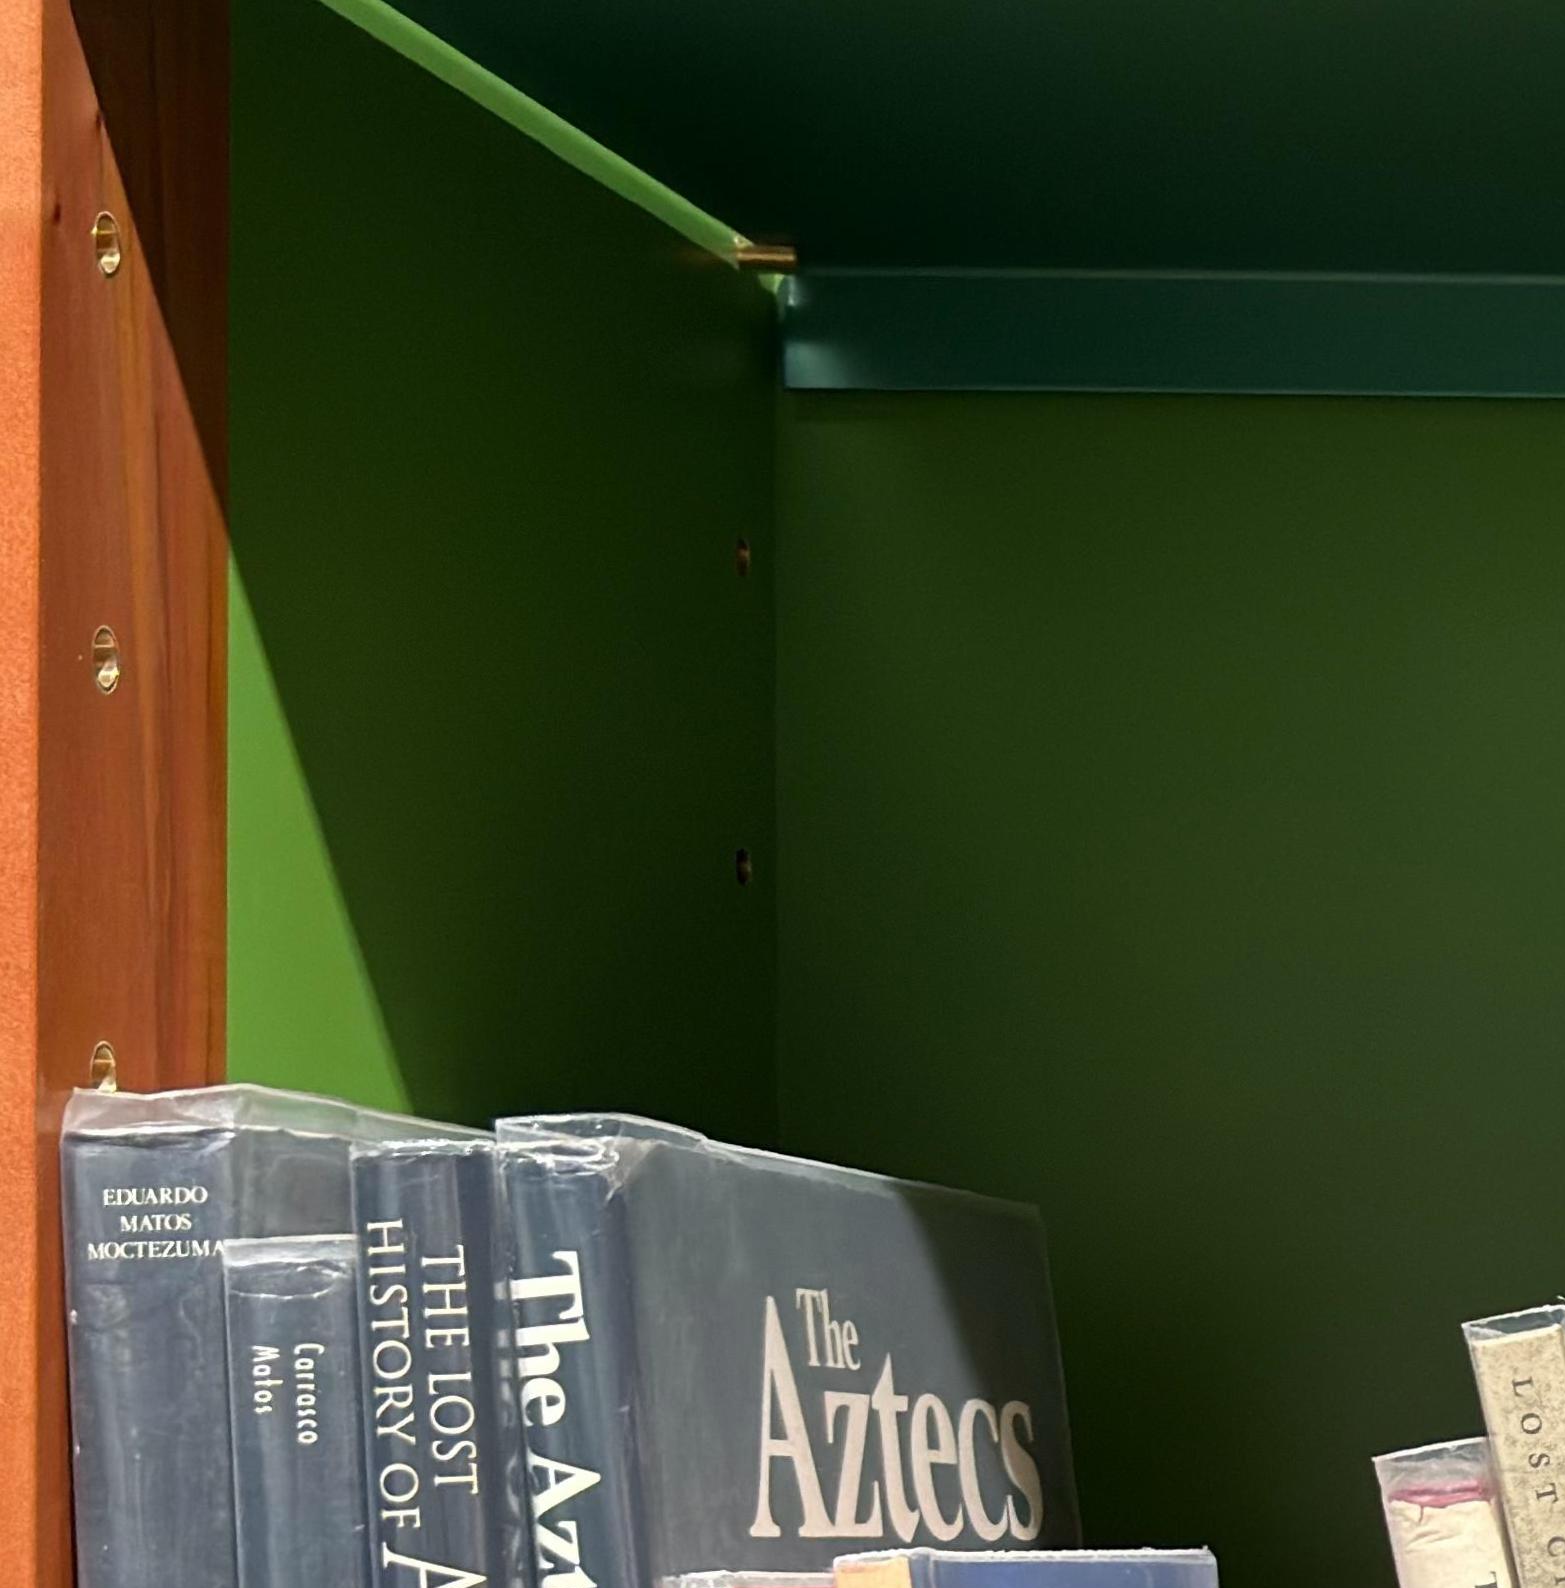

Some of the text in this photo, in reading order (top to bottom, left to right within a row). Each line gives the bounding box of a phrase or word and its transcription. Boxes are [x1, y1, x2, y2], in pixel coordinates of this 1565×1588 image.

[102, 1186, 209, 1208] EDUARDO
[120, 1213, 193, 1233] MATOS
[87, 1239, 225, 1261] MOCTEZUMA
[366, 1219, 416, 1460] HISTORY
[421, 1244, 480, 1495] THE LOST
[509, 1249, 591, 1427] The
[795, 1288, 862, 1372] The
[250, 1345, 280, 1416] Matos
[294, 1343, 325, 1446] Carrasco
[749, 1294, 1044, 1545] Aztecs
[1511, 1376, 1560, 1504] LOST
[379, 1471, 420, 1531] OF
